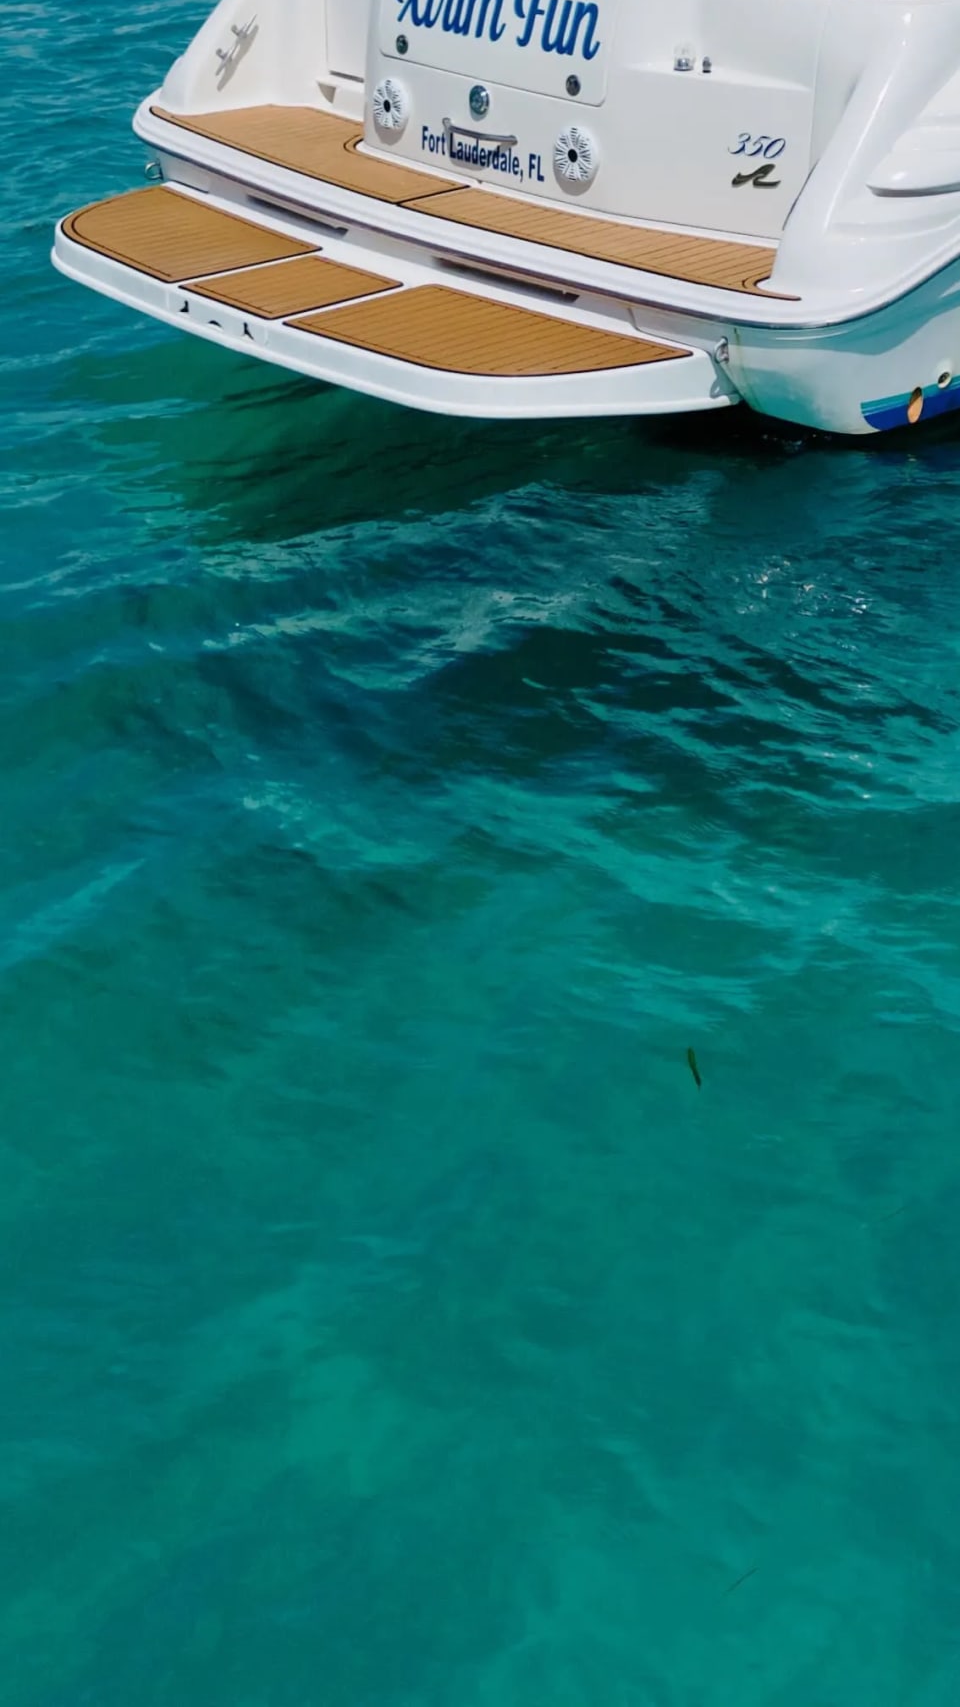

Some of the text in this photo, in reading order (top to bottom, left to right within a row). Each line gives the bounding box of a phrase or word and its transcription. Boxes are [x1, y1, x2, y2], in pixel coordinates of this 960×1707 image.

[421, 125, 545, 182] Fort Lauderdale, FL
[727, 132, 786, 159] 350
